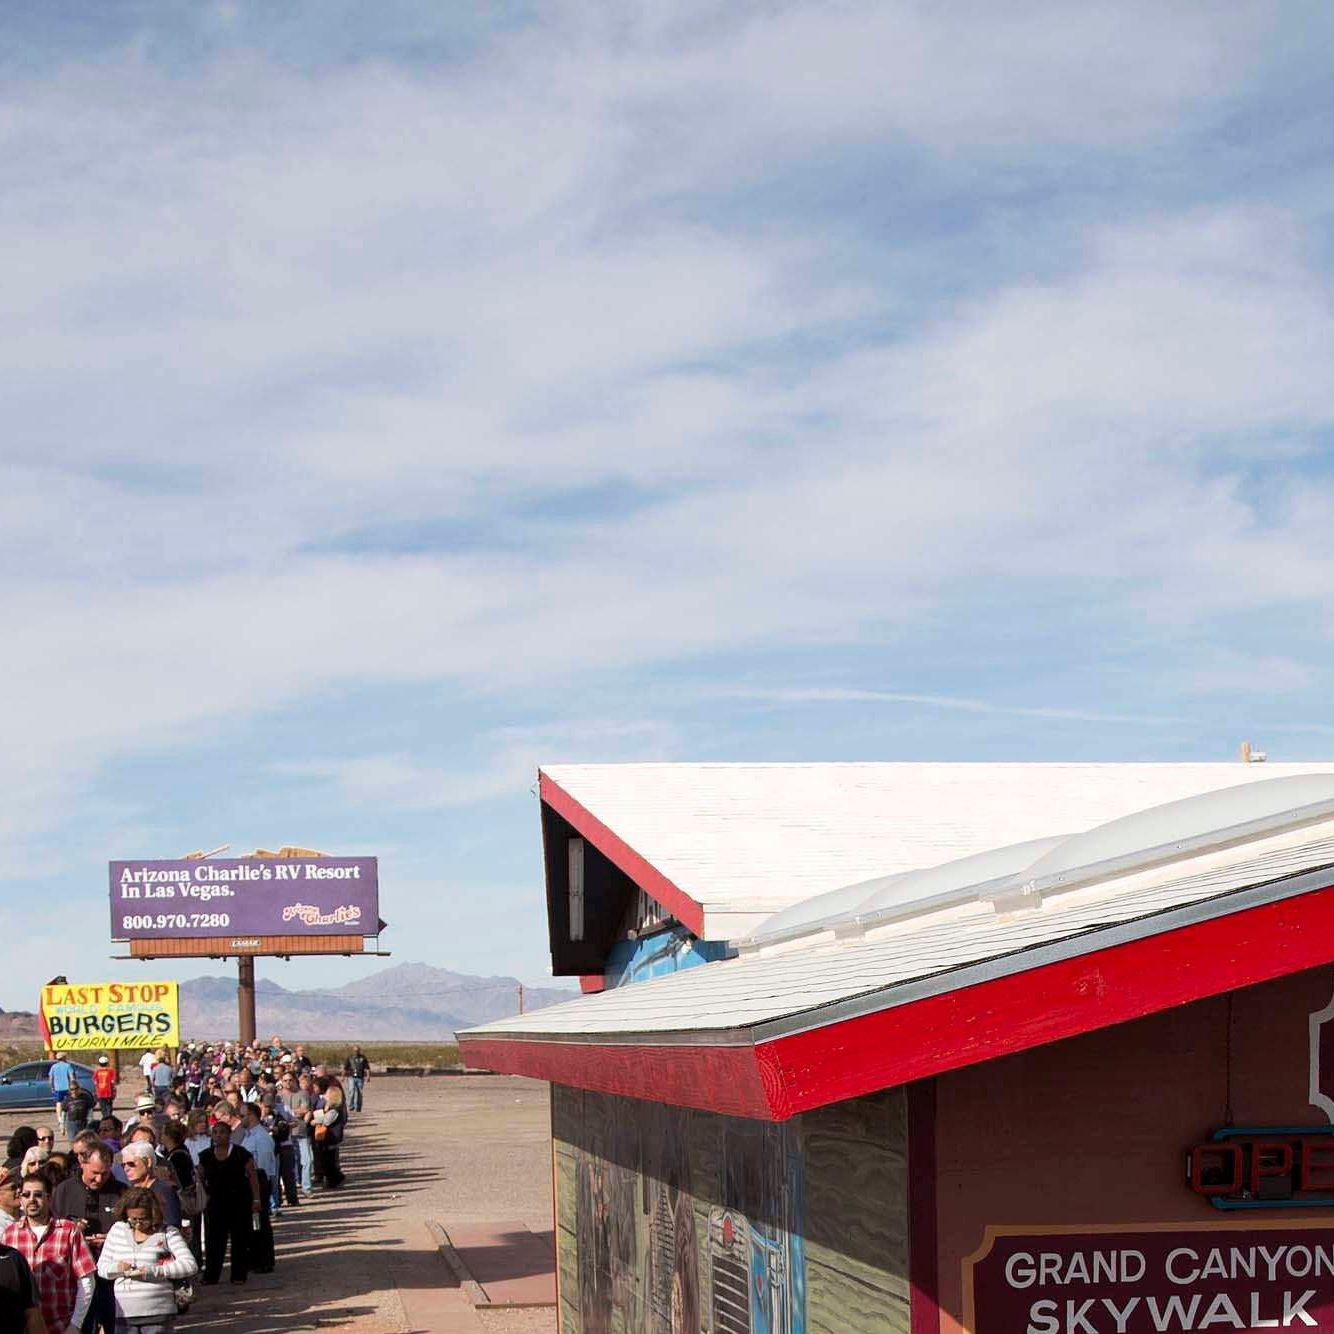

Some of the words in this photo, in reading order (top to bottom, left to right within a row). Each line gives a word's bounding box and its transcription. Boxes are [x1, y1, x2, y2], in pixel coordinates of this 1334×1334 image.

[120, 867, 190, 884] Arizona
[195, 865, 272, 882] Charlie's
[275, 865, 301, 880] RV
[305, 865, 360, 879] Resort
[121, 884, 141, 899] In
[145, 884, 175, 898] Las
[178, 882, 235, 901] Vegas.
[123, 914, 230, 930] 800.970.7280
[300, 905, 361, 925] Charlie's
[46, 987, 103, 1005] LAST
[108, 984, 169, 1003] STOP
[49, 1013, 171, 1035] BURGERS
[56, 1036, 110, 1049] U-TURN
[120, 1033, 165, 1047] MILE
[1005, 1250, 1146, 1289] GRAND
